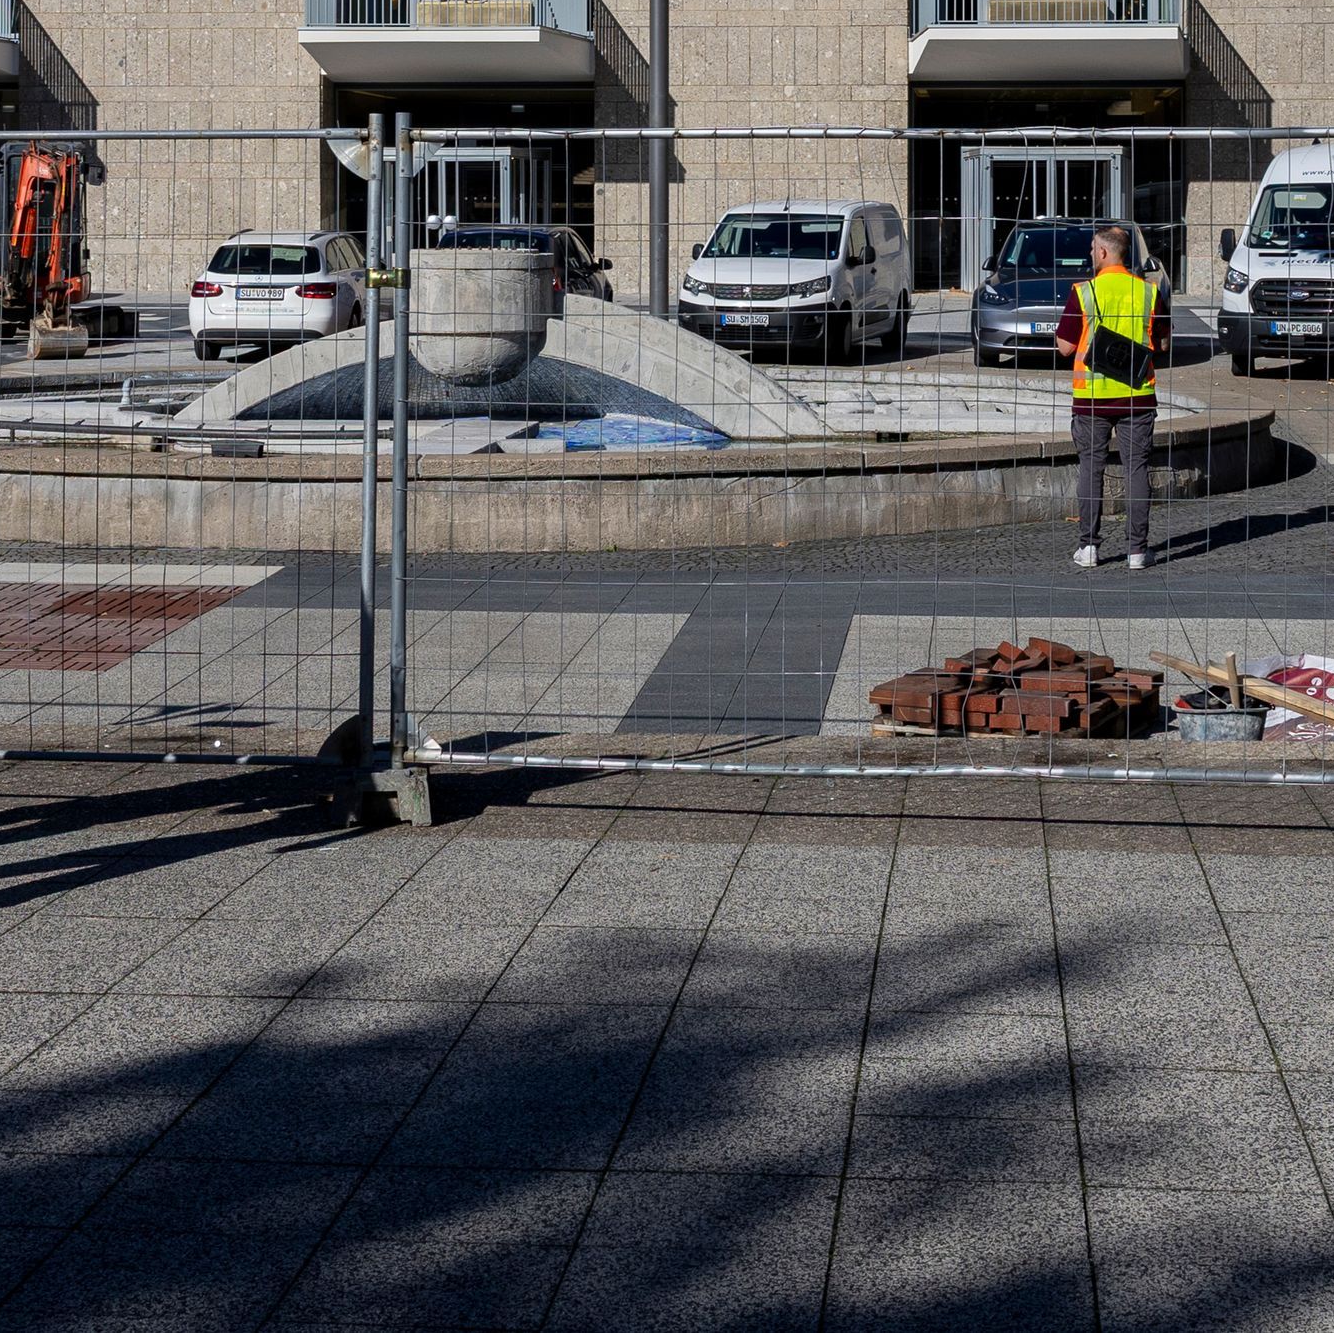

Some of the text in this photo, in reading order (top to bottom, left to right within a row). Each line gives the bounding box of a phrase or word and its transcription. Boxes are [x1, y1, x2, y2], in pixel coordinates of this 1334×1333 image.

[240, 289, 251, 298] SU
[267, 289, 283, 298] 989
[726, 315, 736, 323] SU
[1036, 323, 1042, 332] D
[1276, 322, 1321, 333] UN PC 8006
